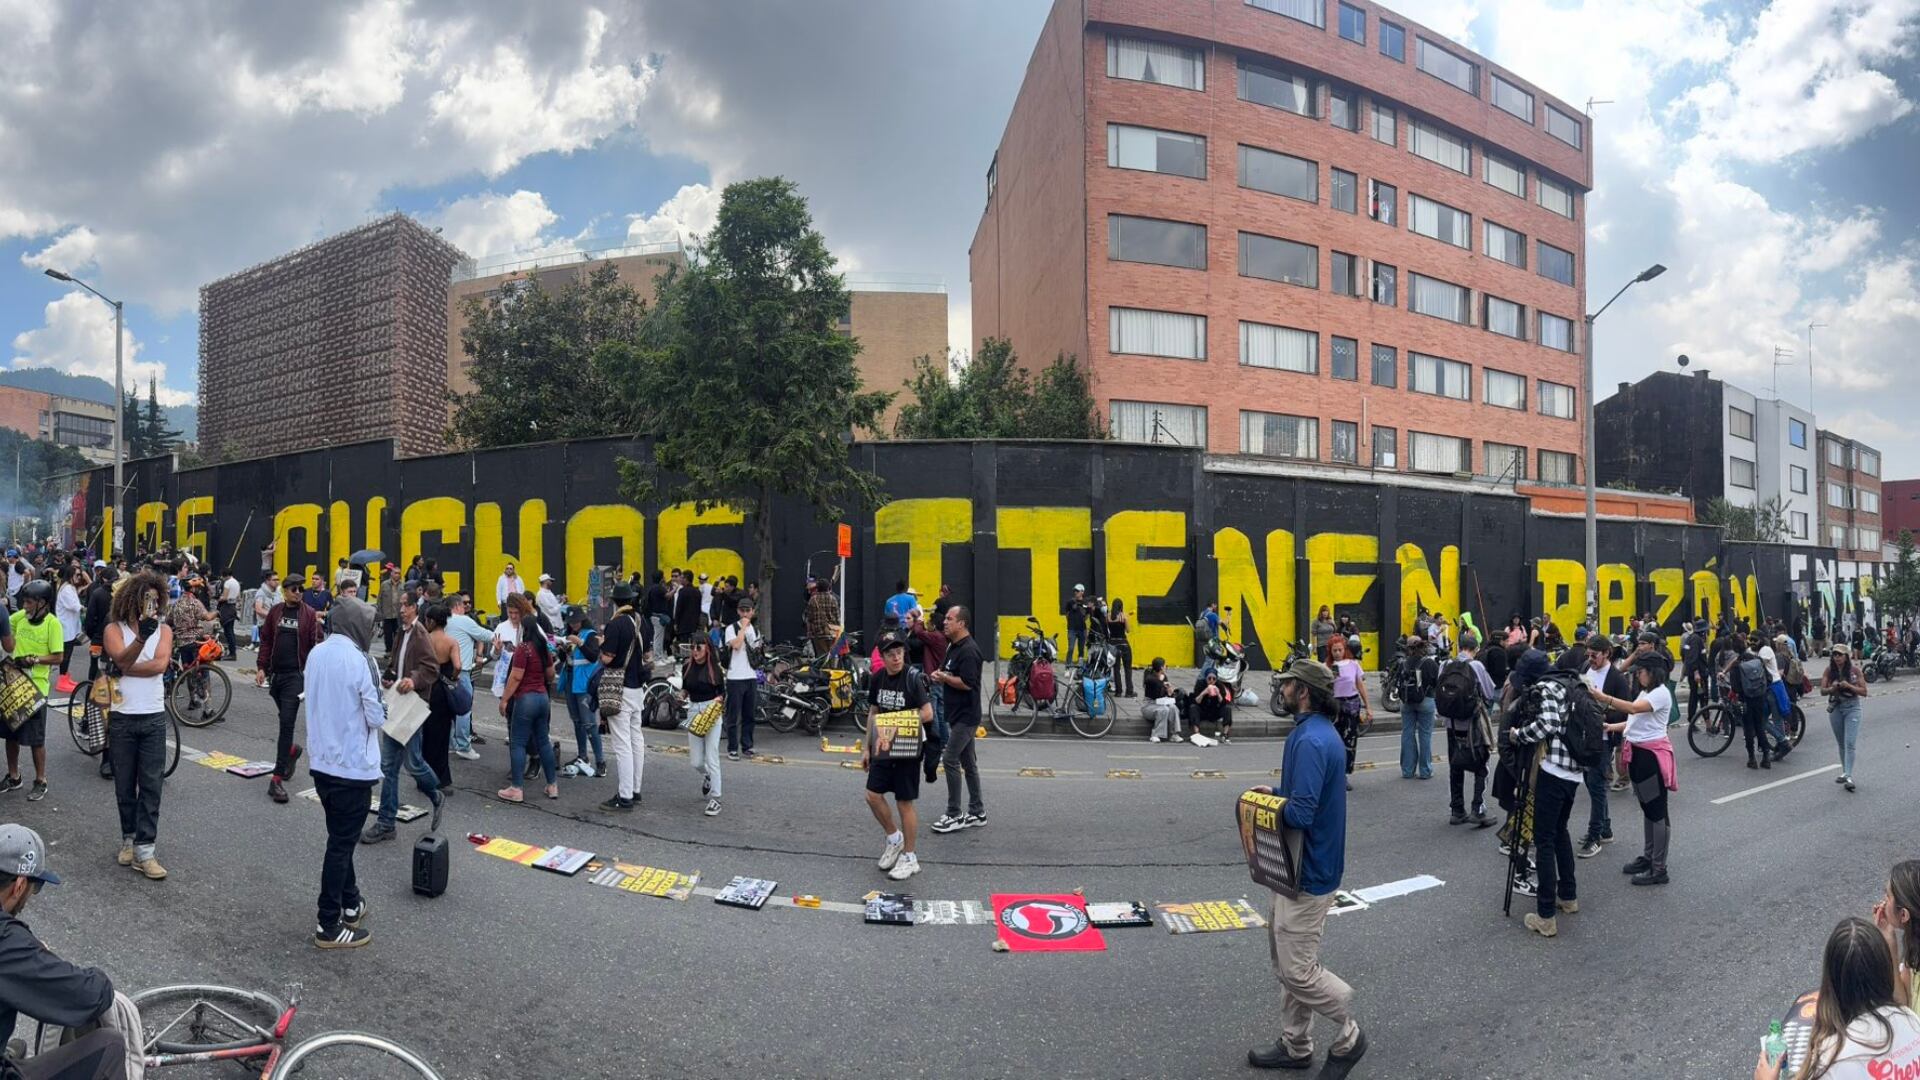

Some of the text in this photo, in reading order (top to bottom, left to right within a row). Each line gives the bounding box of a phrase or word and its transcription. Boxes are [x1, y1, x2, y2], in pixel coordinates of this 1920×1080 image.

[273, 496, 744, 624] CUCHAS
[875, 498, 1460, 672] TIENEN
[1537, 556, 1757, 661] RAZÓN
